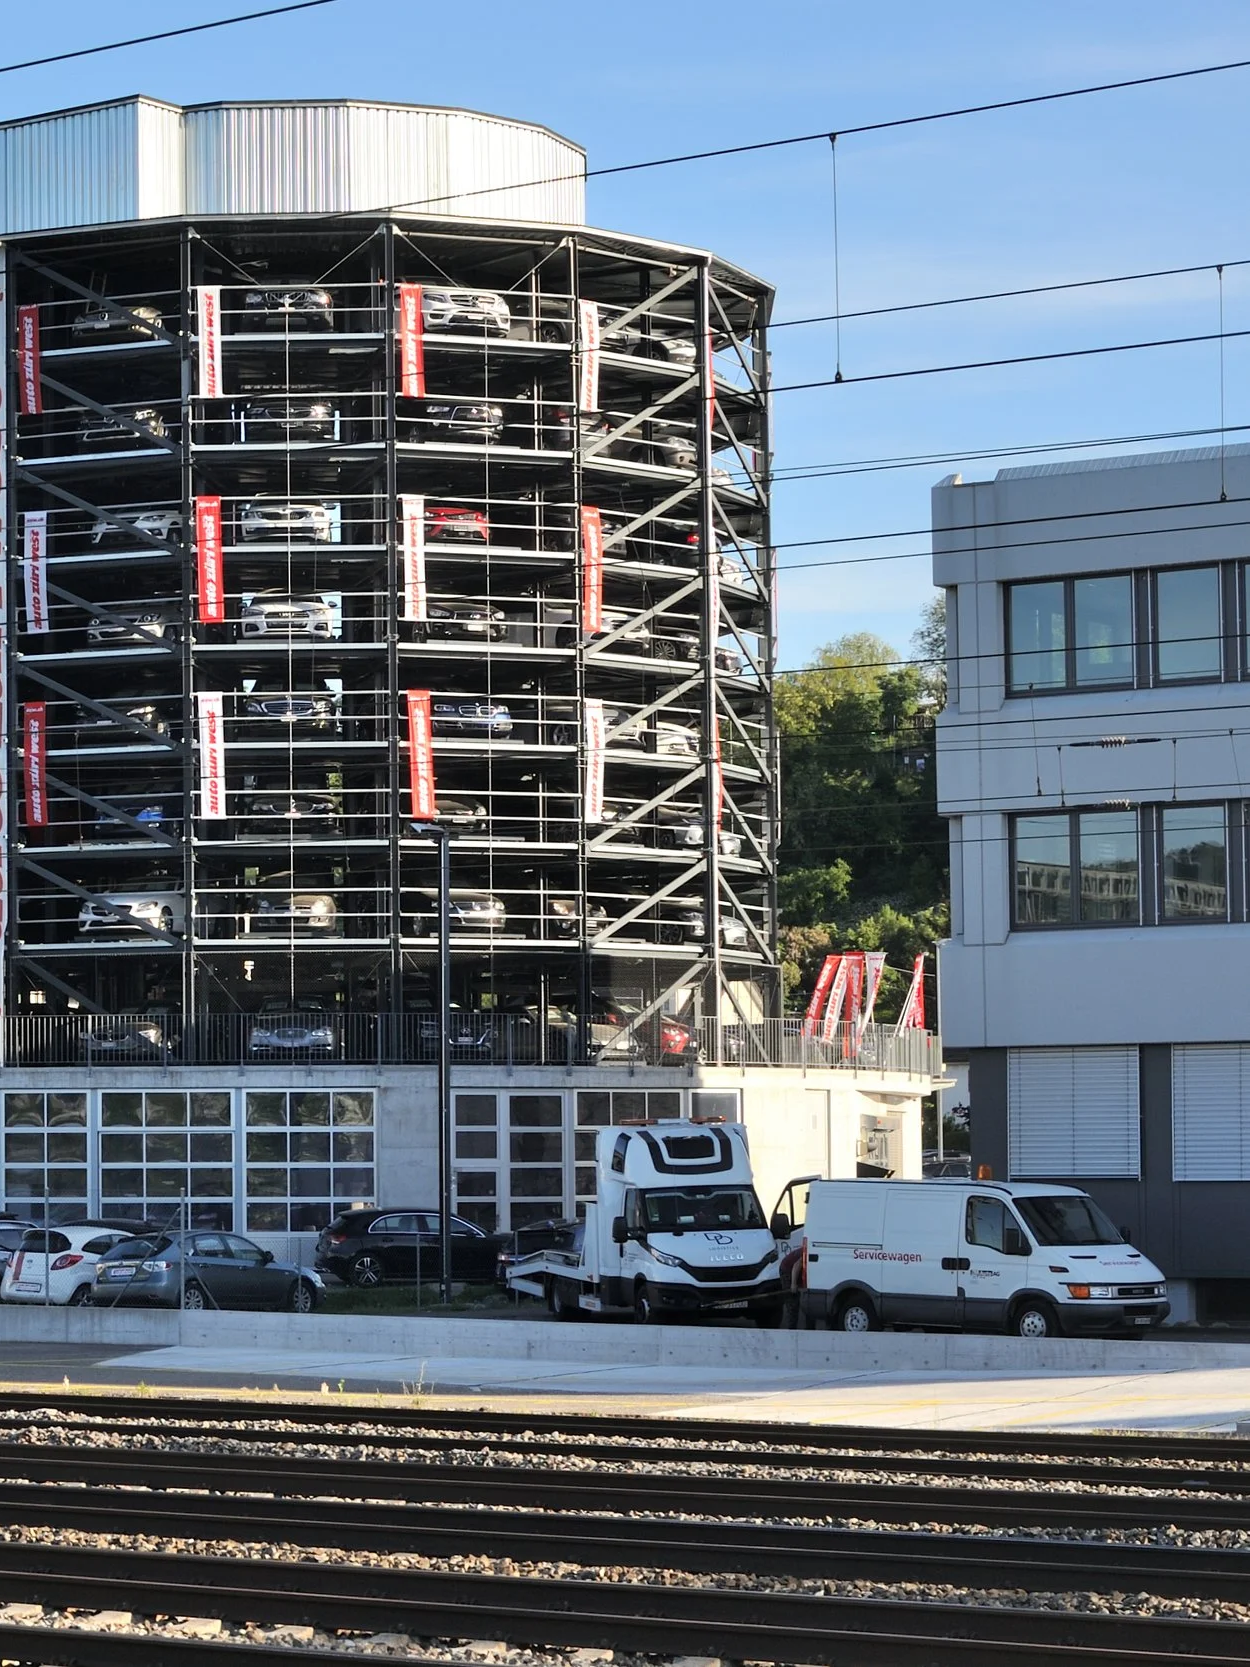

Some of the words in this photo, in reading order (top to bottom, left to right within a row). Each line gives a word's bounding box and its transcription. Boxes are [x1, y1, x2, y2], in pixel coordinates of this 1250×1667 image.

[204, 292, 214, 328] west
[23, 316, 34, 349] west
[26, 381, 37, 414] auto
[206, 362, 216, 399] auto
[29, 529, 40, 562] west
[202, 515, 215, 548] west
[32, 596, 43, 630] auto
[206, 581, 218, 618] auto
[29, 719, 40, 754] west
[206, 710, 217, 745] west
[31, 788, 42, 824] auto
[209, 779, 219, 815] auto
[853, 1249, 922, 1265] Servicewagen
